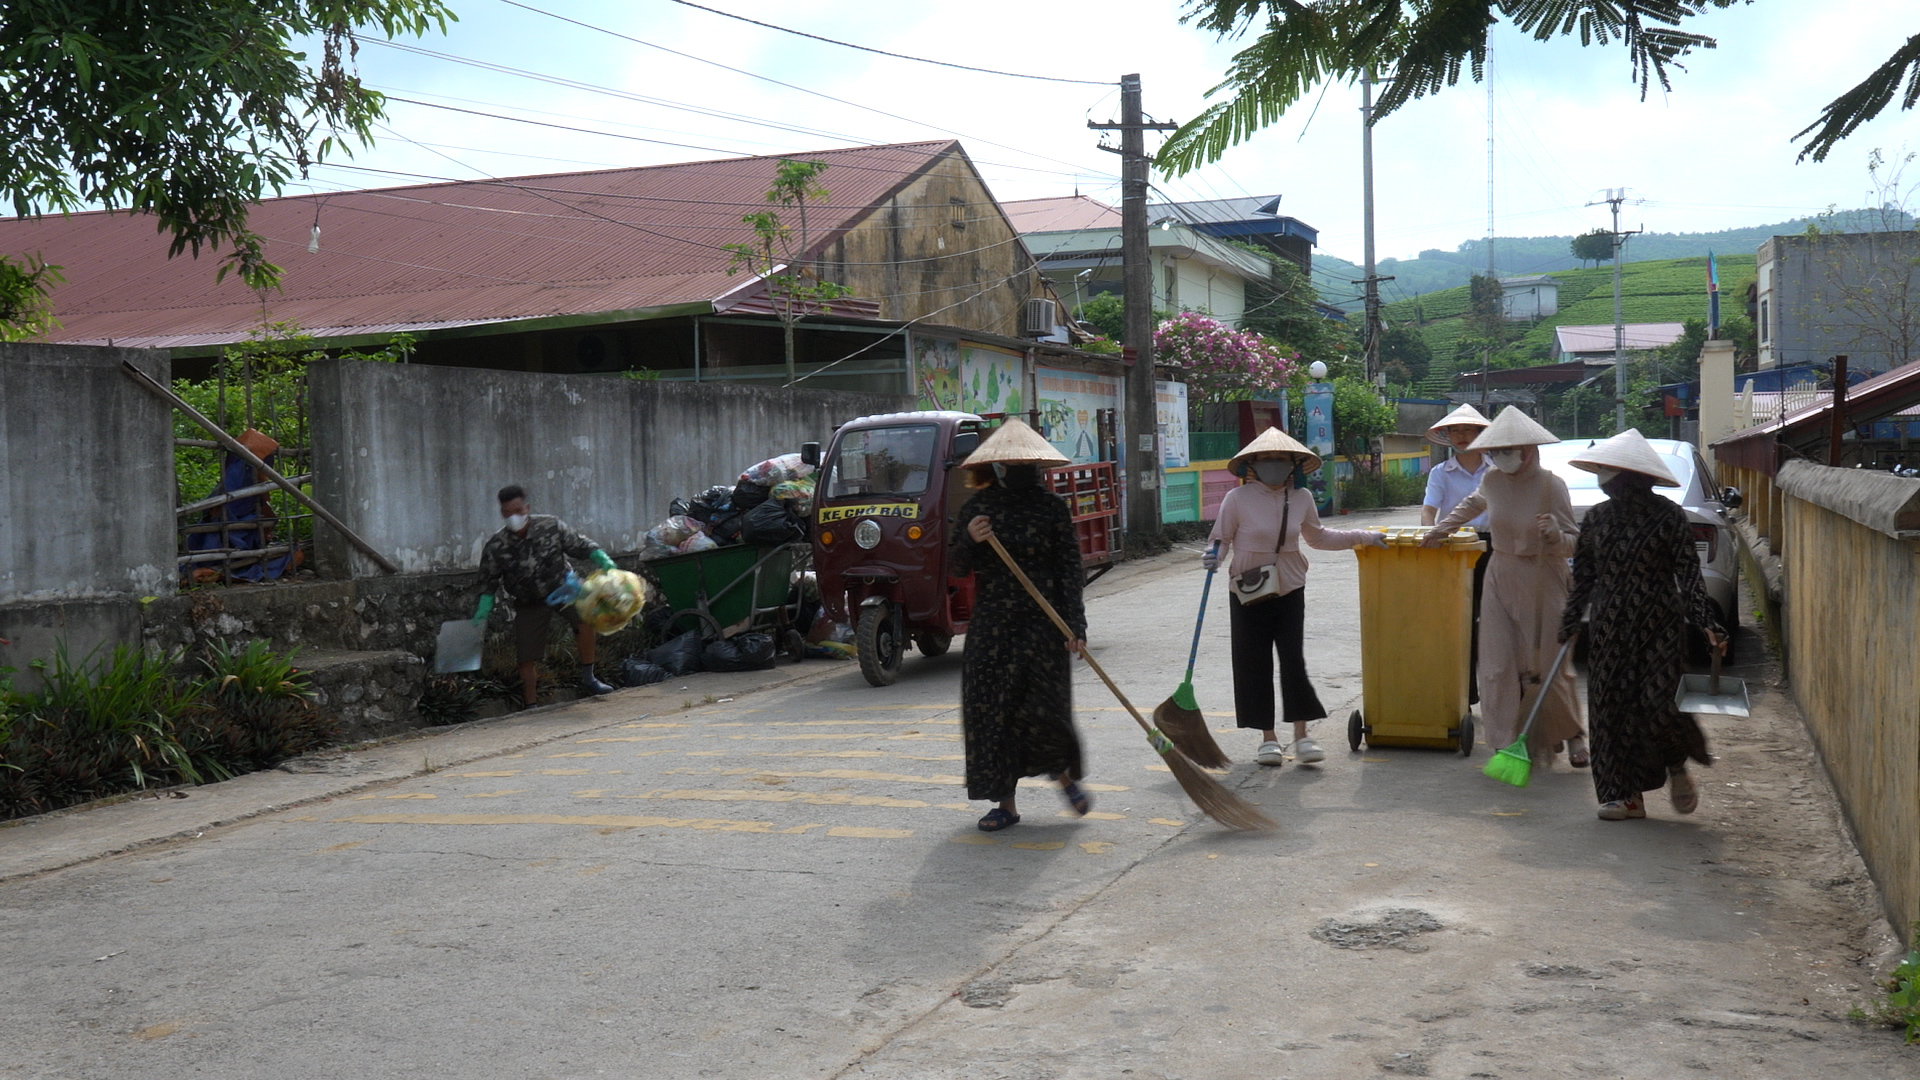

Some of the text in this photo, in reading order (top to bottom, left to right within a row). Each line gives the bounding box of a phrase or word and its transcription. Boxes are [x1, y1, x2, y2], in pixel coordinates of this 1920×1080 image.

[1312, 405, 1322, 417] A
[1318, 426, 1327, 437] B
[844, 505, 877, 518] CHỞ
[879, 505, 914, 517] RÁC
